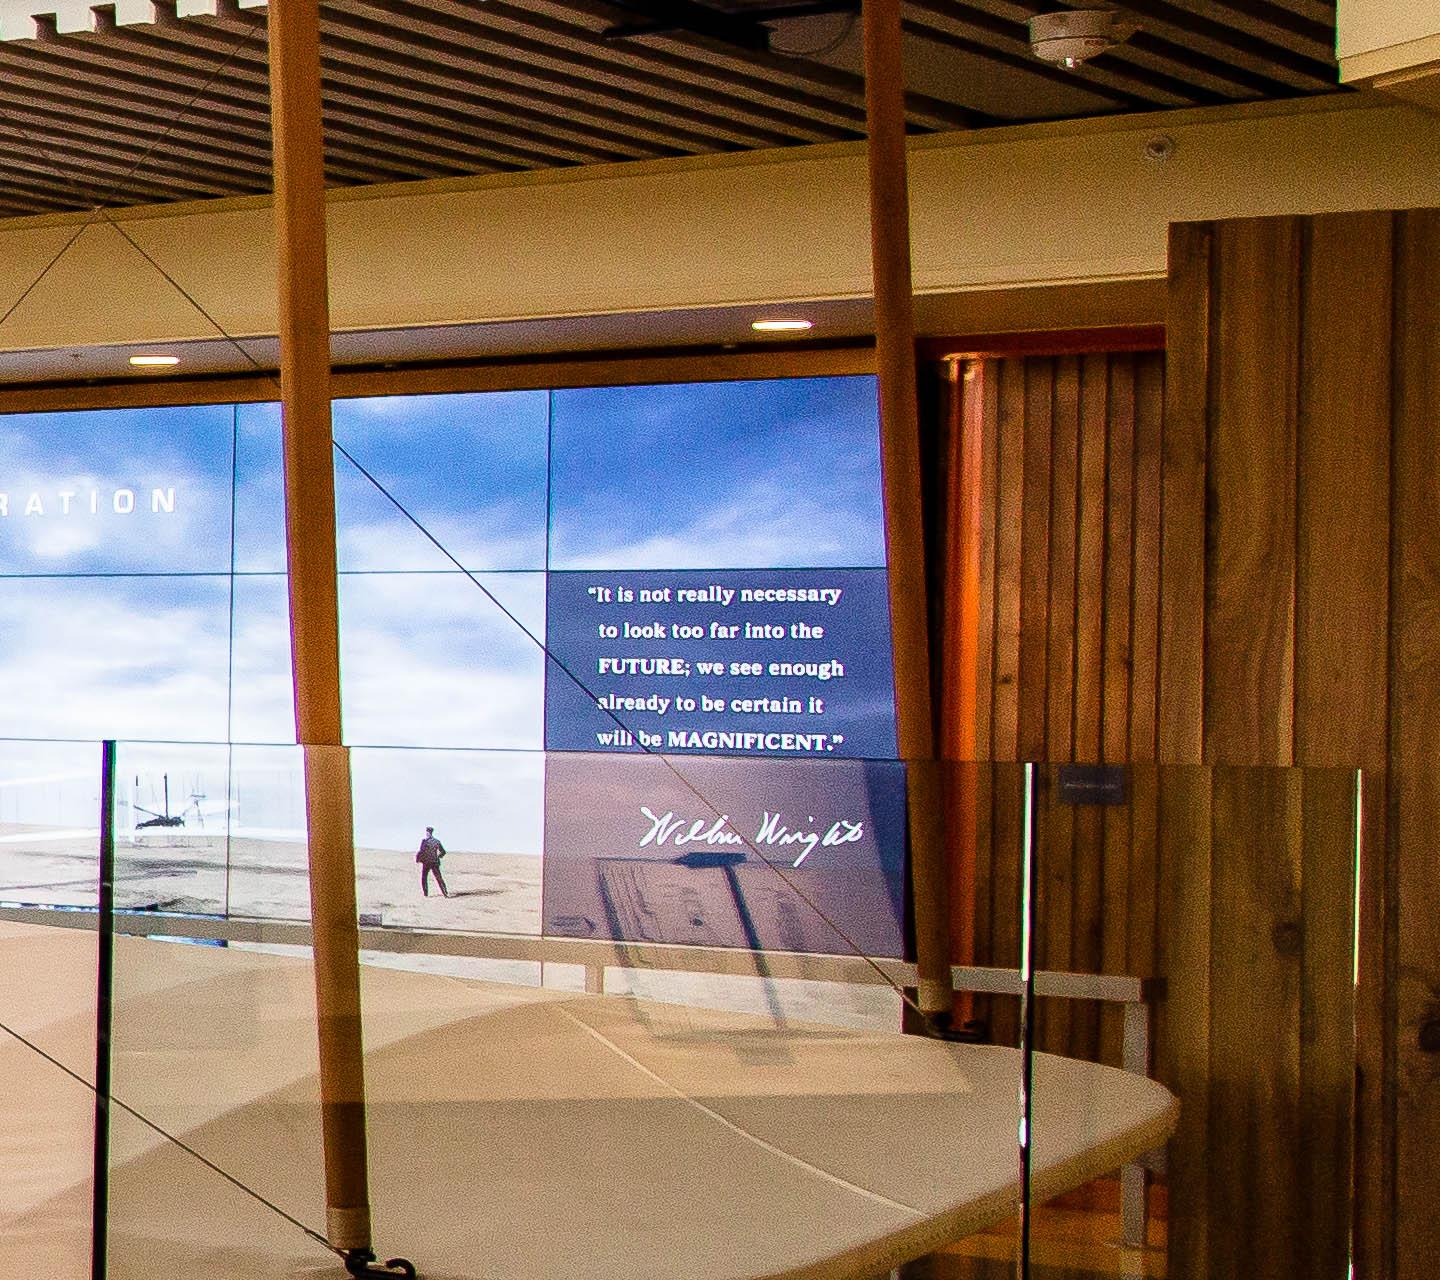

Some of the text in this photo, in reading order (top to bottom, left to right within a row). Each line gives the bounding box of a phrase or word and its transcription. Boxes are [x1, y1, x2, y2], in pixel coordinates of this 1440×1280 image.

[617, 587, 633, 602] is
[640, 588, 670, 602] not
[677, 586, 734, 606] really
[740, 589, 841, 605] necessary
[598, 623, 823, 638] to look too far into the
[598, 659, 844, 680] FUTURE; we see enough
[597, 695, 823, 715] already to be certain it
[597, 731, 632, 746] will
[638, 731, 662, 747] be
